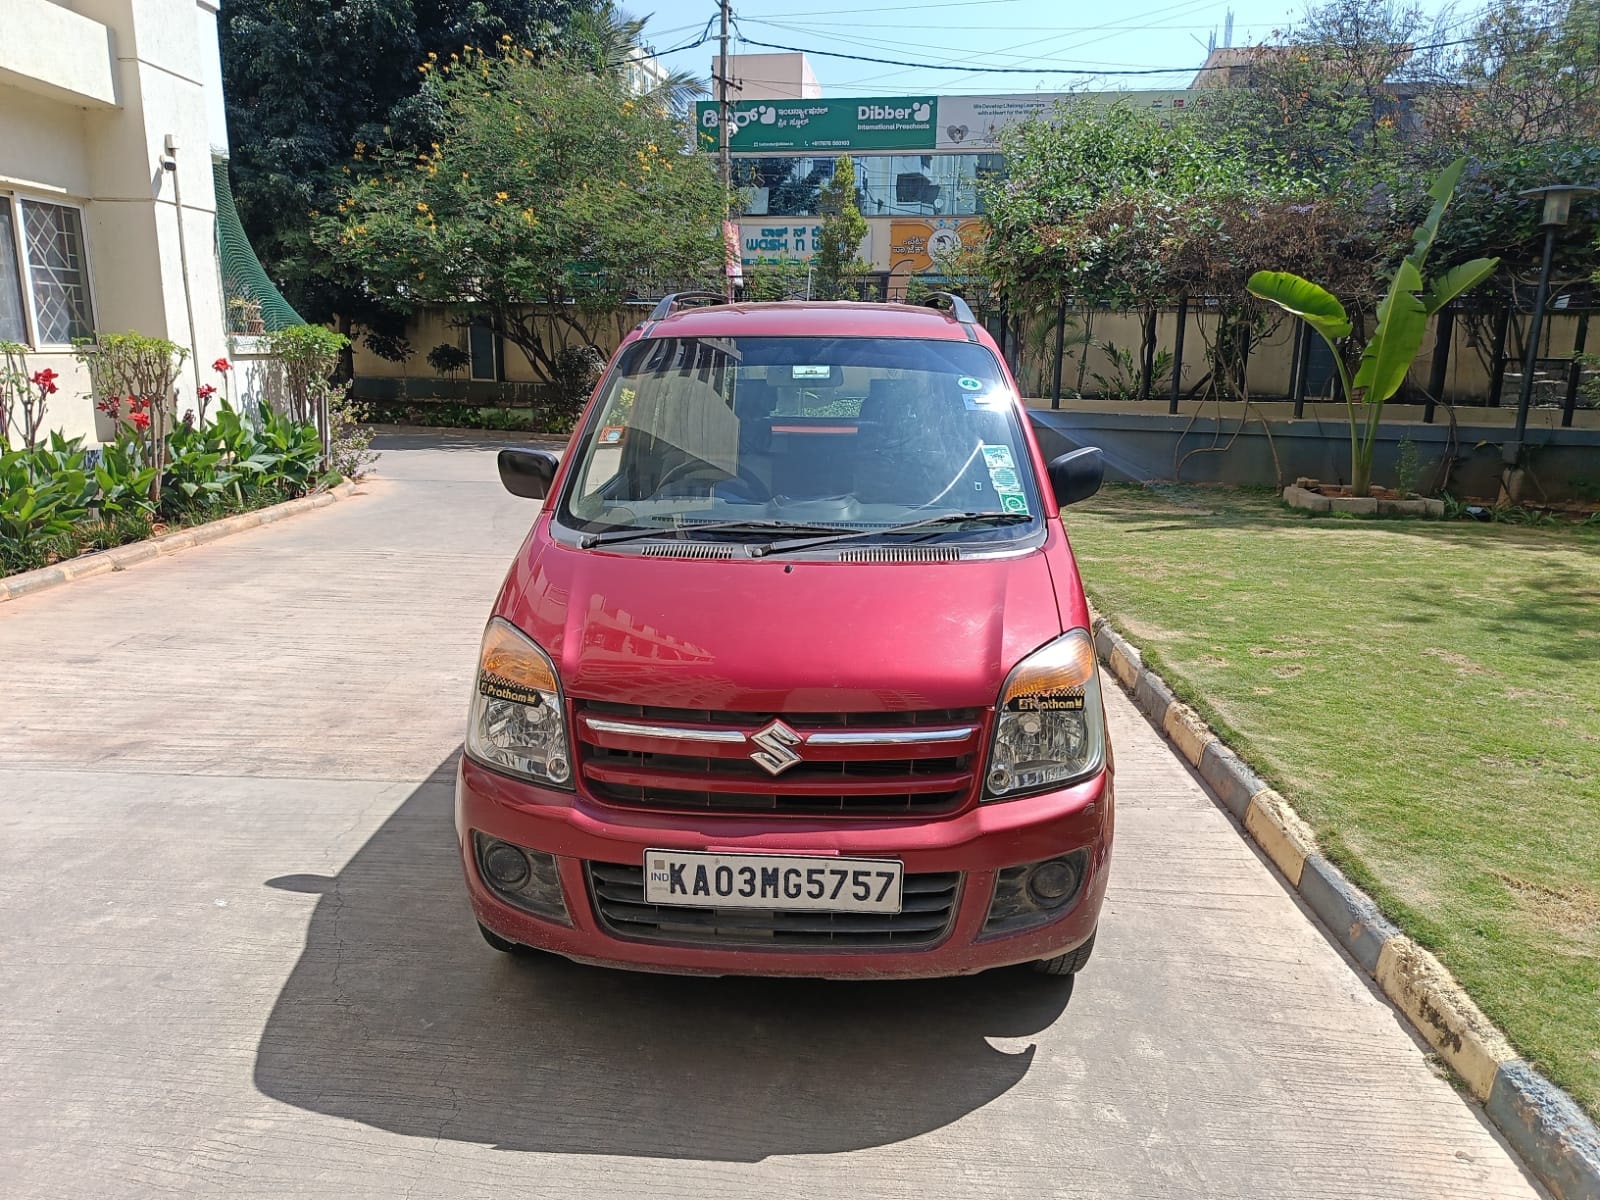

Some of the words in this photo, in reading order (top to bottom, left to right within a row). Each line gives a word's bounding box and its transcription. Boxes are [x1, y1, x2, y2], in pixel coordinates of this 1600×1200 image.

[857, 105, 912, 120] Dibber
[857, 123, 895, 131] International
[487, 684, 527, 703] Pratham
[651, 871, 669, 882] IND
[668, 862, 895, 902] KA03MG5757
